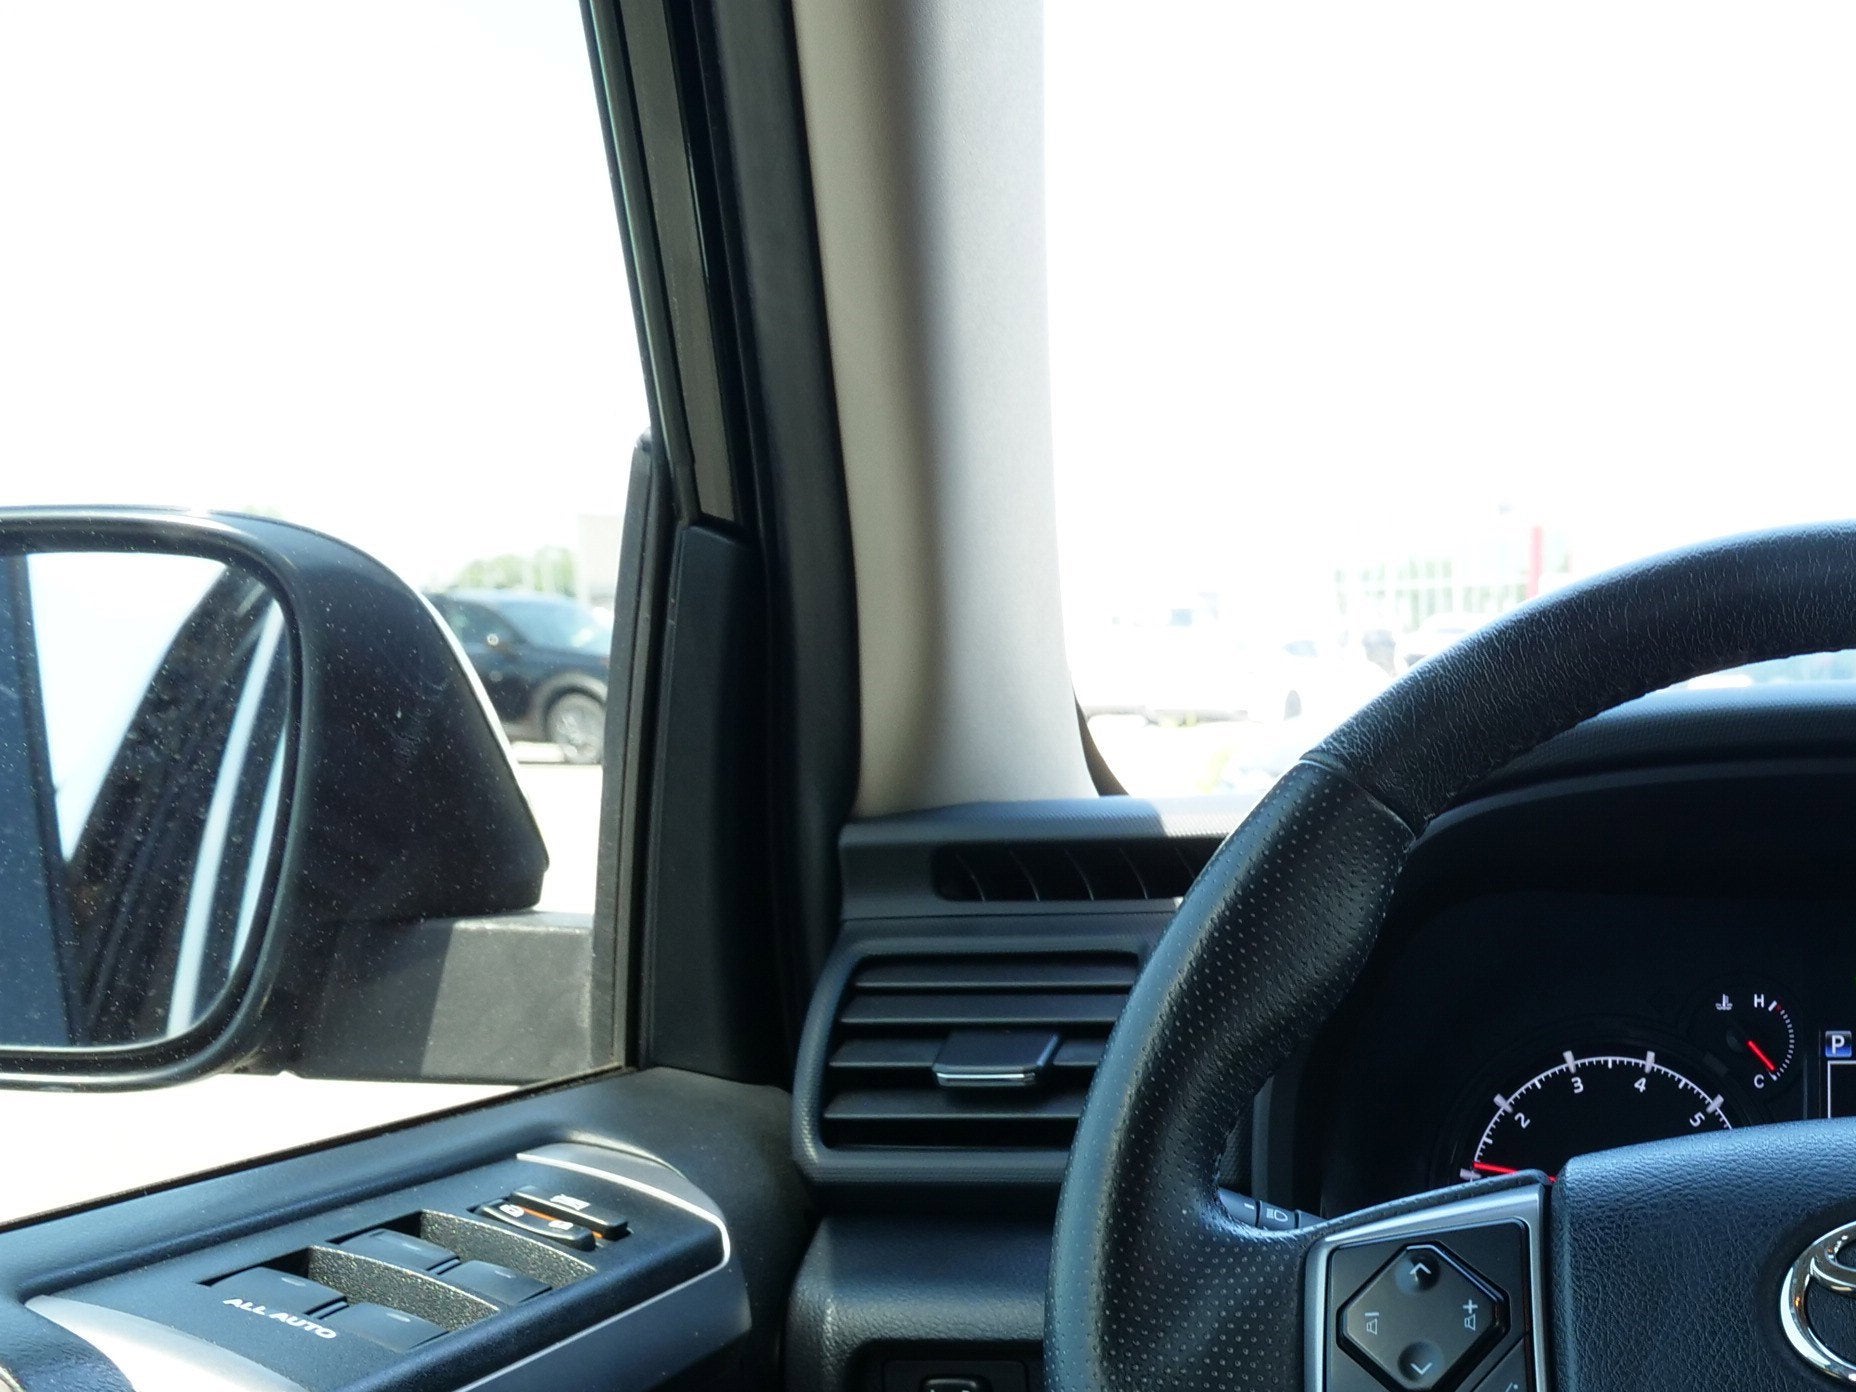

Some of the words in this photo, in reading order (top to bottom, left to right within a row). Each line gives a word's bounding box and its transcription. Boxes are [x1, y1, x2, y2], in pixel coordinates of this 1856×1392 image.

[1753, 993, 1765, 1008] H
[1831, 1034, 1846, 1055] P
[1571, 1077, 1584, 1093] 3
[1633, 1077, 1646, 1093] 4
[1753, 1073, 1765, 1089] C
[1514, 1112, 1531, 1129] 2
[1689, 1112, 1706, 1128] 5
[223, 1298, 266, 1316] ALL
[268, 1312, 337, 1339] AUTO
